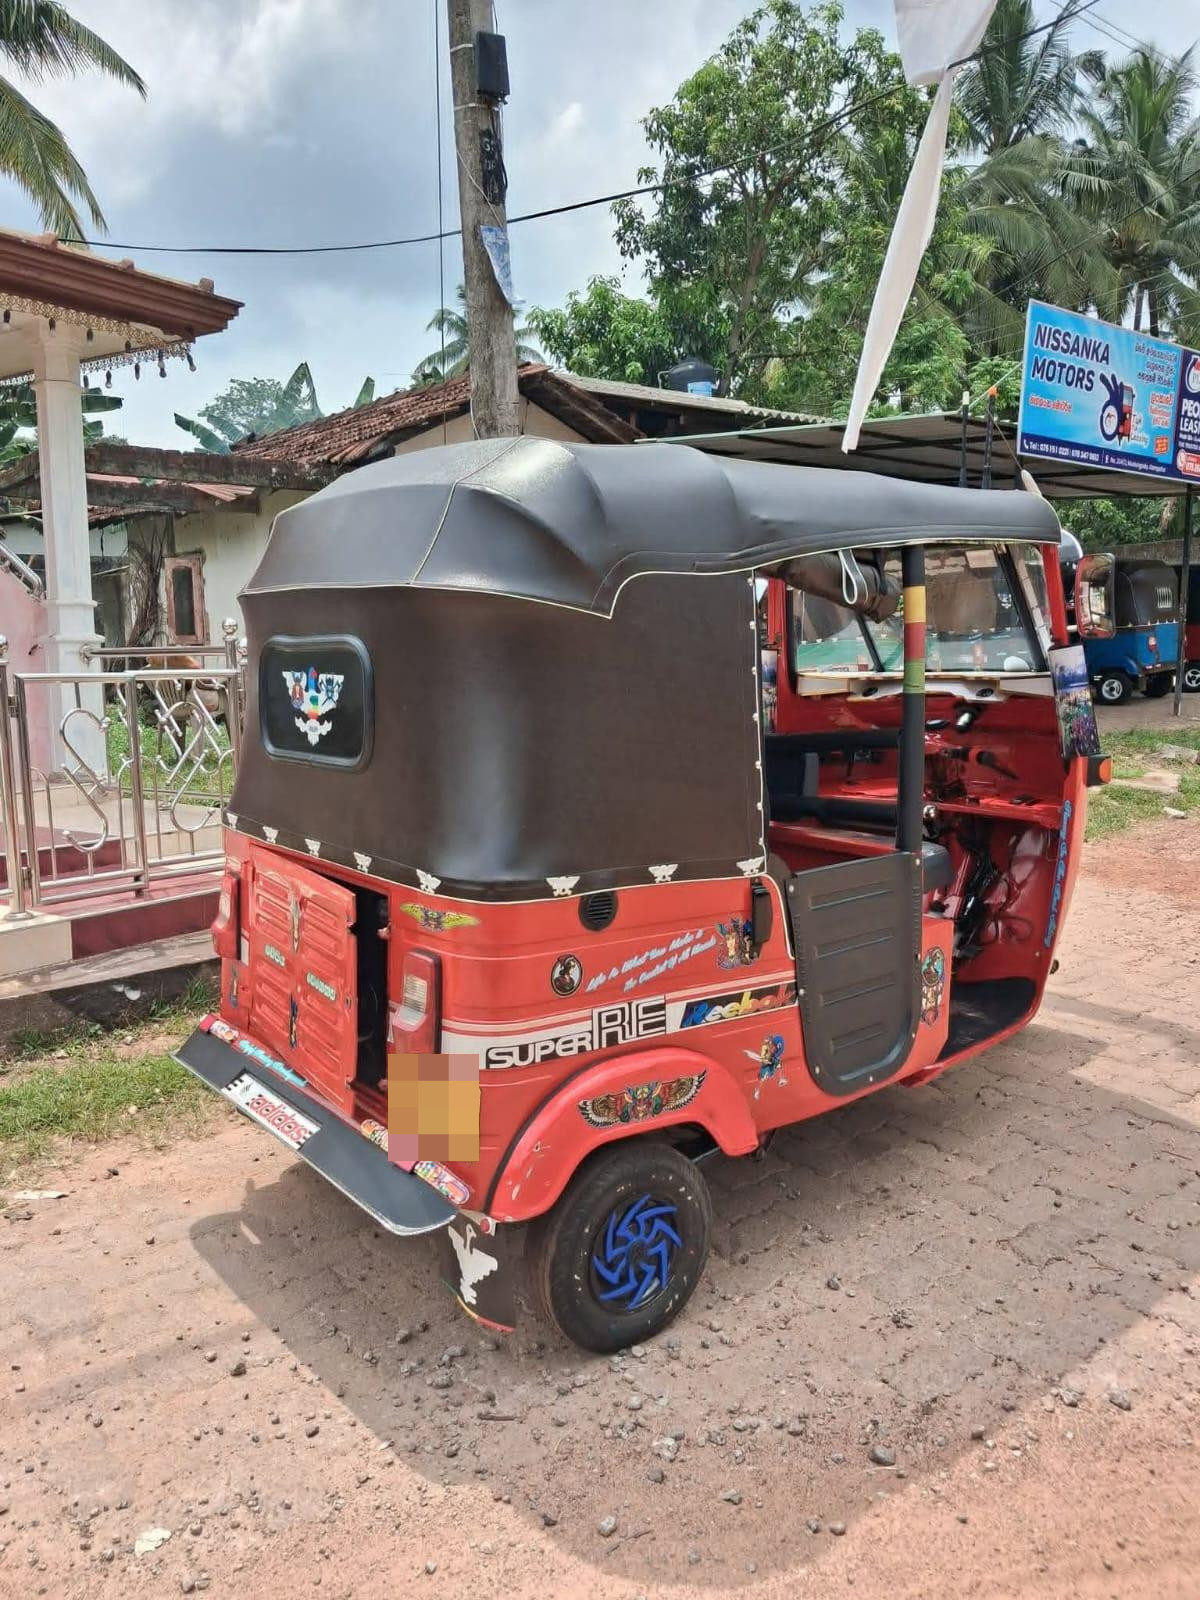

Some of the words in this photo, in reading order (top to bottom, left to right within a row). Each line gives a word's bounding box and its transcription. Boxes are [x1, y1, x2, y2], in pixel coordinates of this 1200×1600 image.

[1034, 324, 1110, 365] NISSANKA
[1031, 356, 1095, 392] MOTORS
[1181, 398, 1200, 418] PEO
[682, 985, 796, 1029] Reebok
[486, 1031, 593, 1069] SUPER
[248, 1095, 309, 1142] adidas
